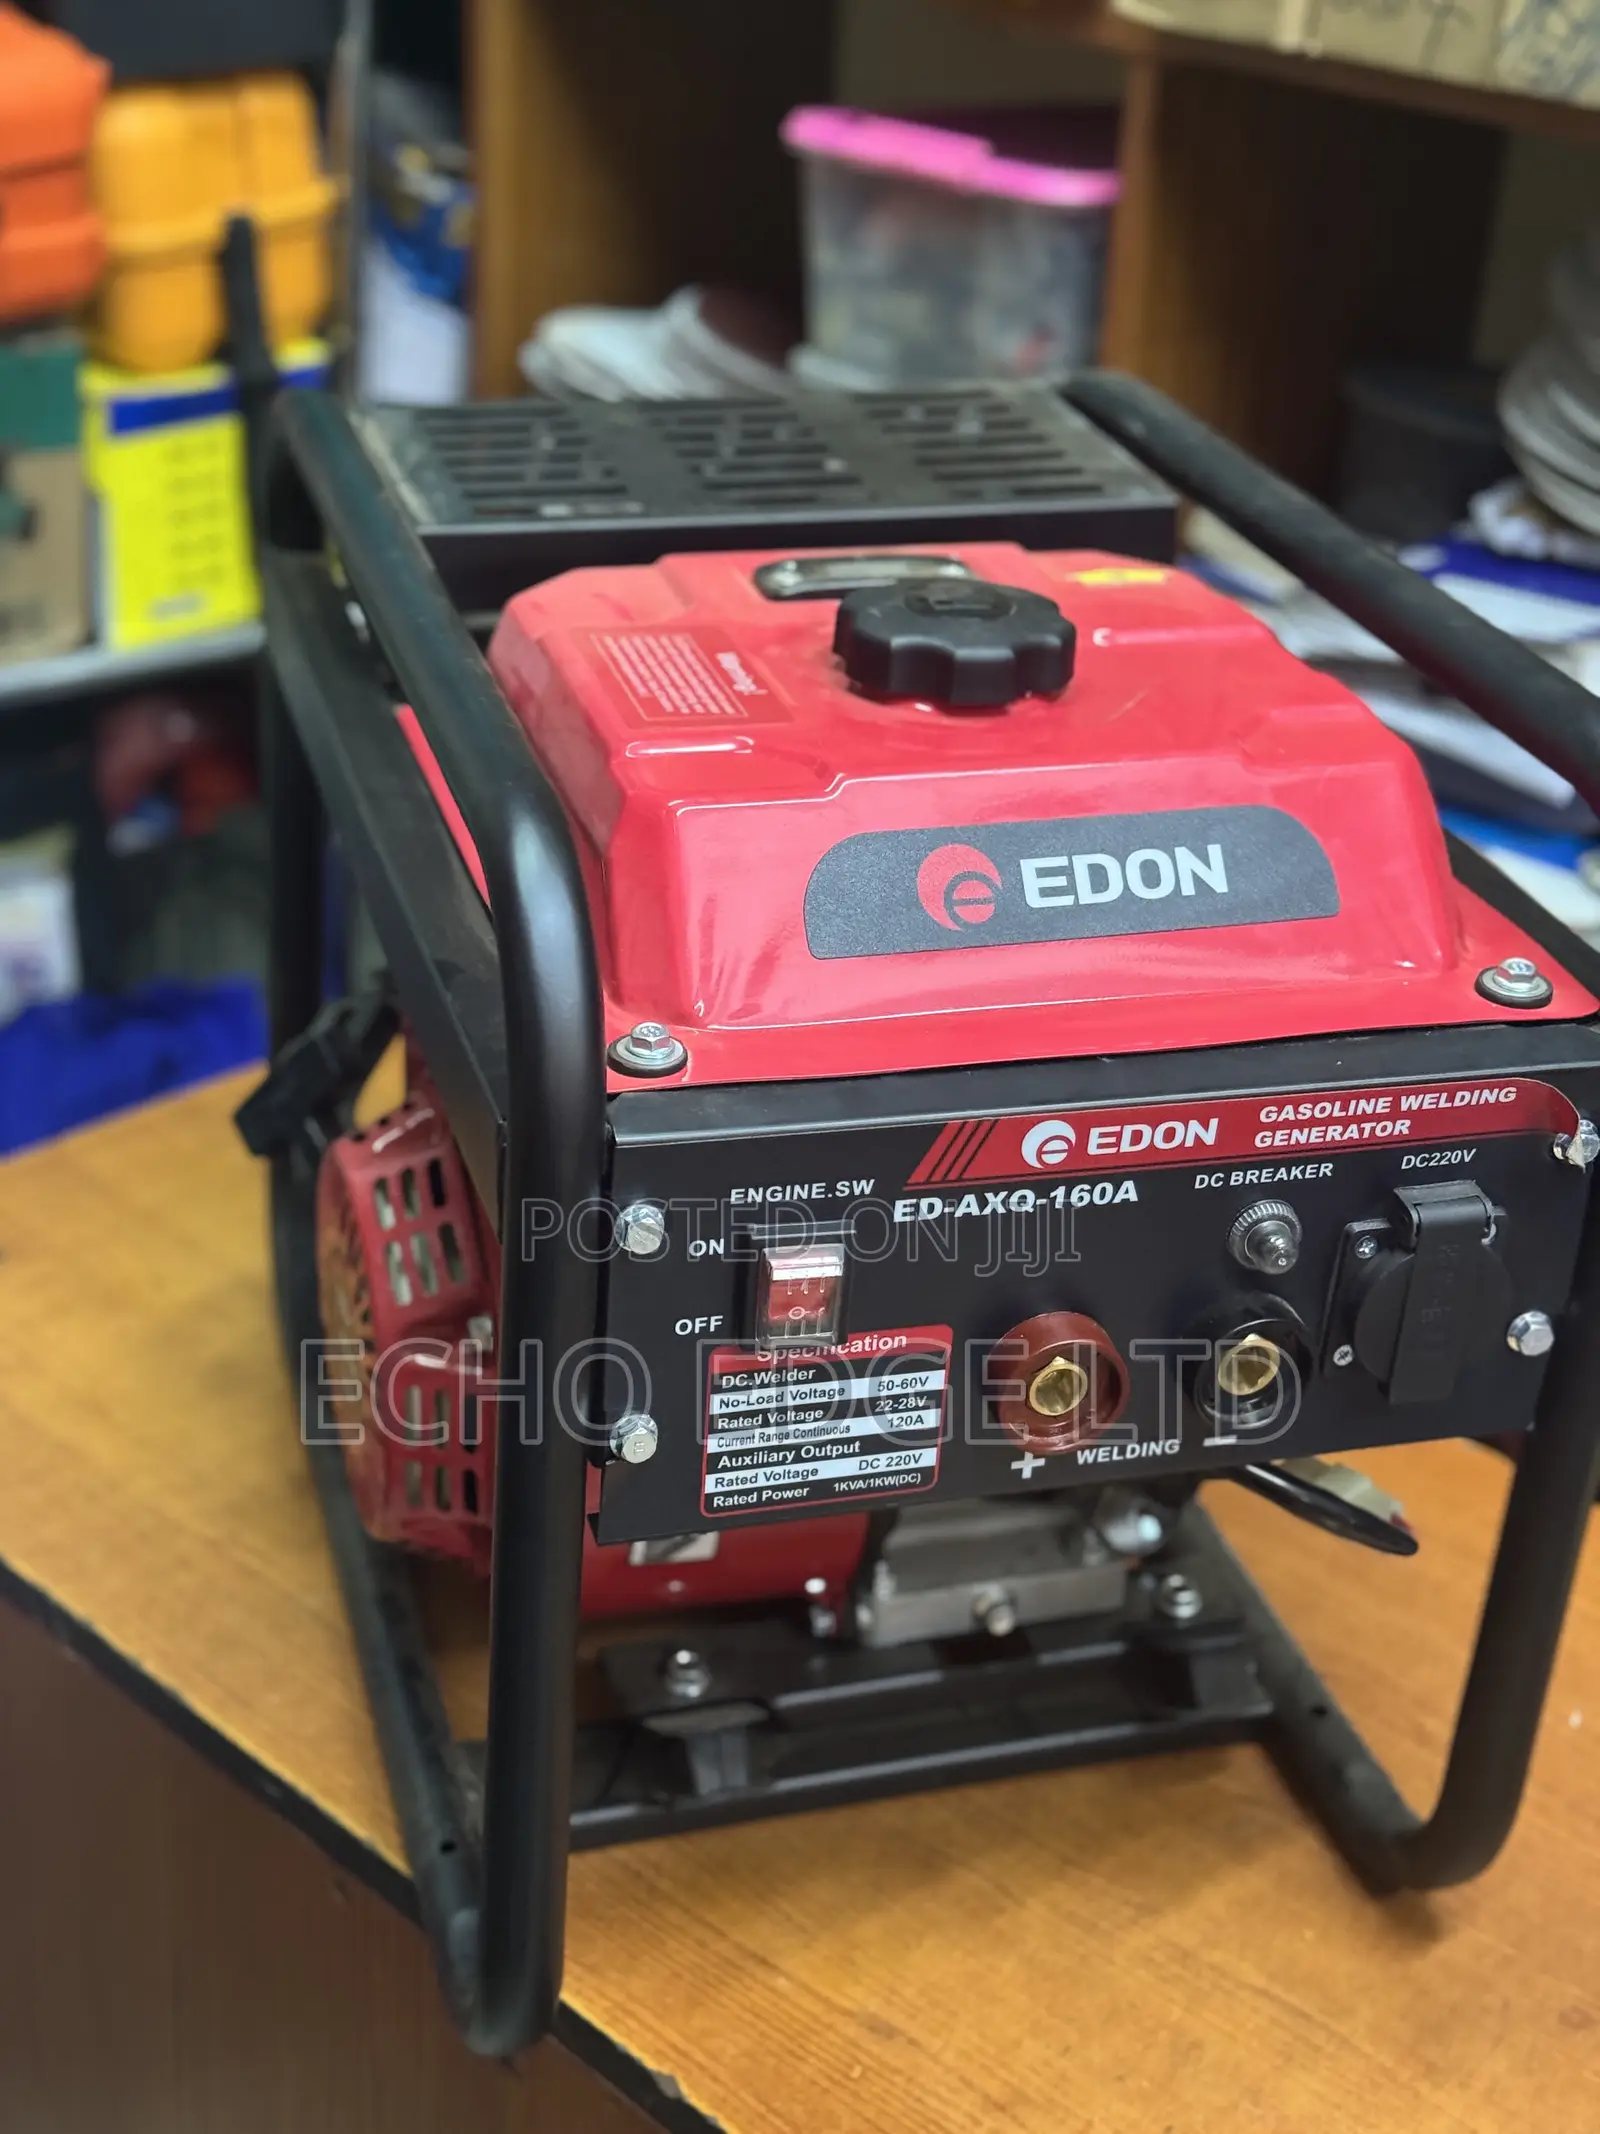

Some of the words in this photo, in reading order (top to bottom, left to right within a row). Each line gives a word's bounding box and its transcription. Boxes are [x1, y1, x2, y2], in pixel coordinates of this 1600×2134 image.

[1020, 844, 1229, 908] EDON
[1259, 1096, 1392, 1123] GASOLINE
[1400, 1086, 1518, 1112] WELDING
[1086, 1117, 1220, 1157] EDON
[1253, 1119, 1412, 1149] GENERATOR
[1401, 1148, 1477, 1171] DC220V
[1194, 1173, 1224, 1190] DC
[1229, 1162, 1334, 1187] BREAKER
[729, 1179, 876, 1205] ENGINE.SW
[893, 1180, 1138, 1222] ED-AXQ-160A
[689, 1238, 725, 1257] ON
[674, 1315, 724, 1336] OFF
[719, 1394, 784, 1410] No-Load
[789, 1385, 846, 1405] Voltage
[877, 1375, 930, 1393] 50-60V
[721, 1368, 817, 1389] DC.Welder
[717, 1415, 763, 1430] Rated
[767, 1408, 824, 1427] Voltage
[874, 1395, 928, 1412] 22-28V
[717, 1433, 756, 1448] Current
[758, 1430, 790, 1446] Range
[793, 1423, 851, 1440] Continuous
[887, 1416, 925, 1430] 120A
[717, 1448, 795, 1469] Auxiliary
[800, 1440, 861, 1461] Output
[1077, 1440, 1180, 1465] WELDING
[714, 1474, 759, 1488] Rated
[763, 1466, 819, 1487] Voltage
[858, 1458, 881, 1472] DC
[884, 1453, 923, 1469] 220V
[712, 1493, 757, 1508] Rated
[761, 1486, 810, 1503] Power
[833, 1473, 921, 1492] 1KVA/1KW(DC)
